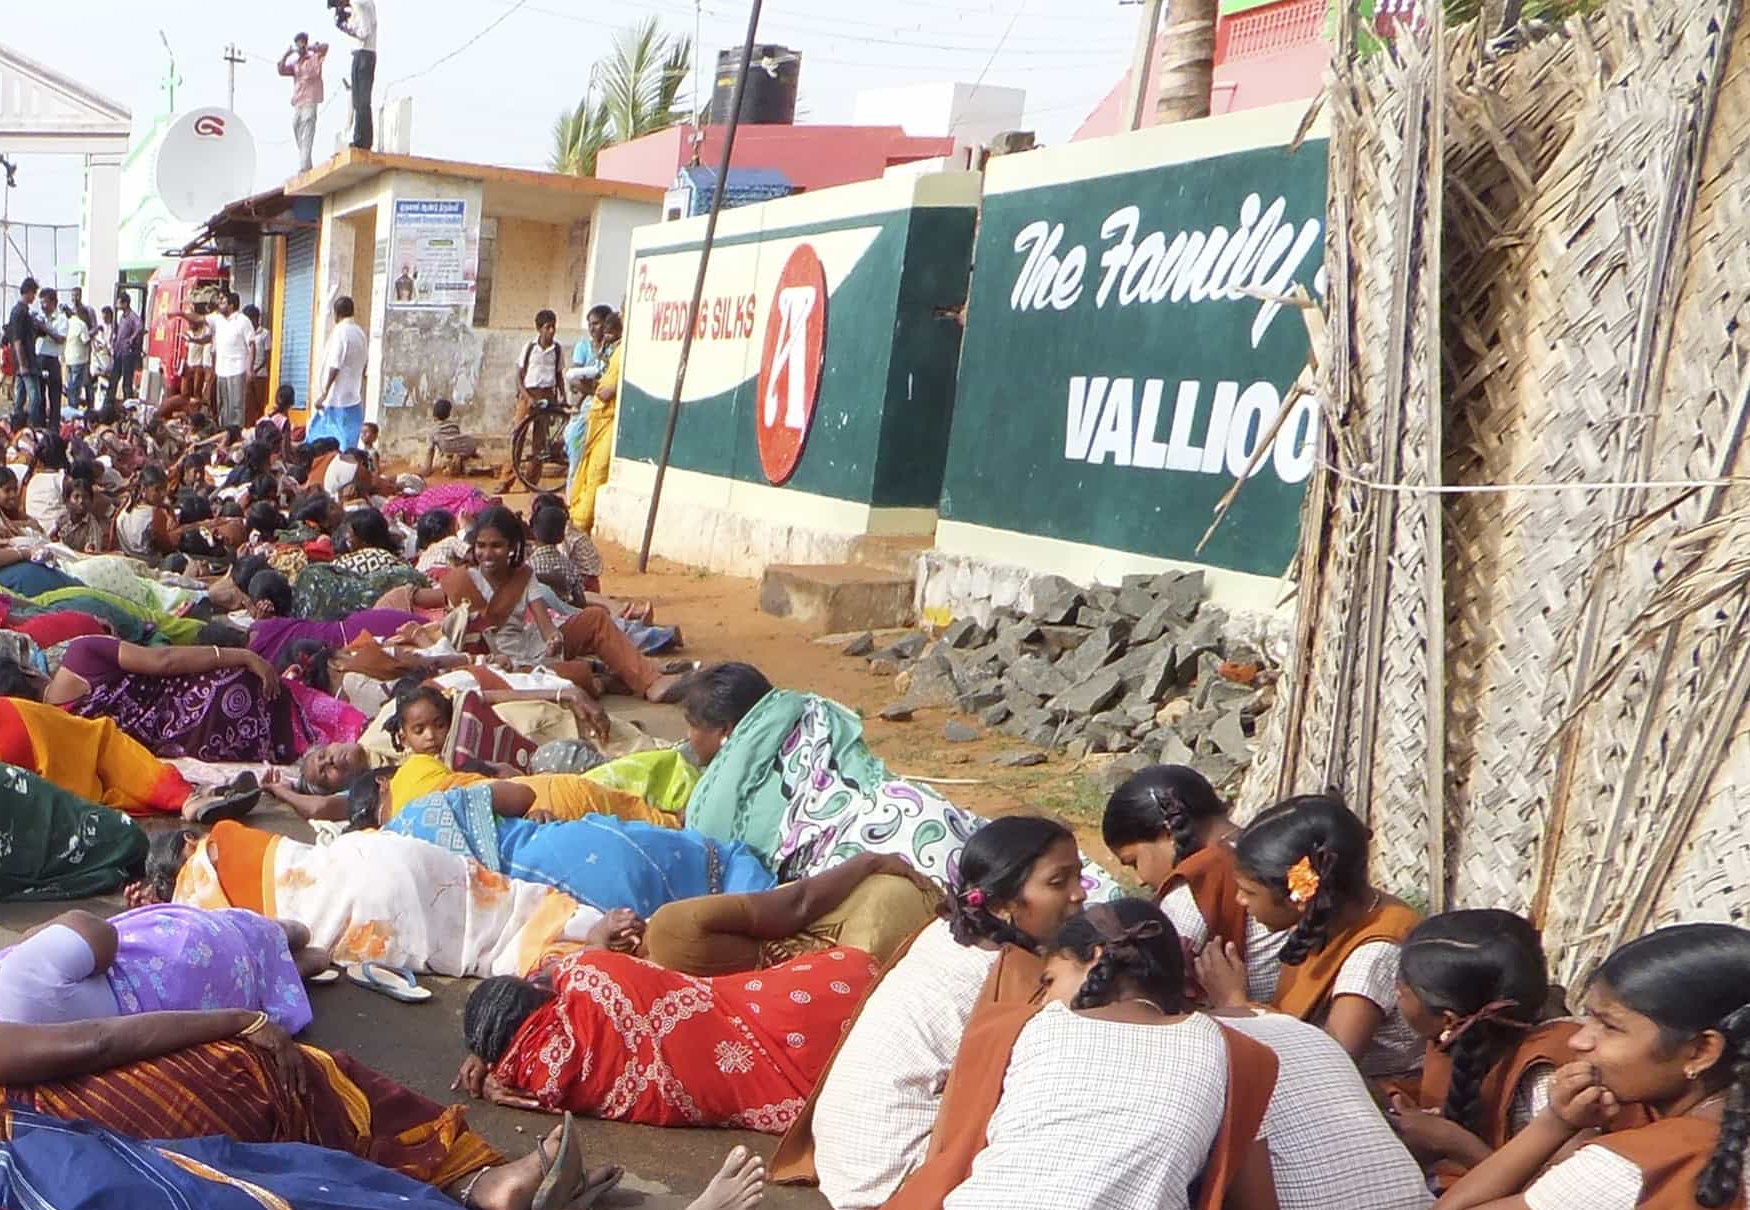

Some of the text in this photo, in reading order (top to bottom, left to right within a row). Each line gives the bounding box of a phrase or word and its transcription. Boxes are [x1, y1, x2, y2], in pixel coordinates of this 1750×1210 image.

[637, 263, 658, 303] For
[1010, 192, 1321, 349] The Family
[651, 293, 757, 341] WEDDG SILKS
